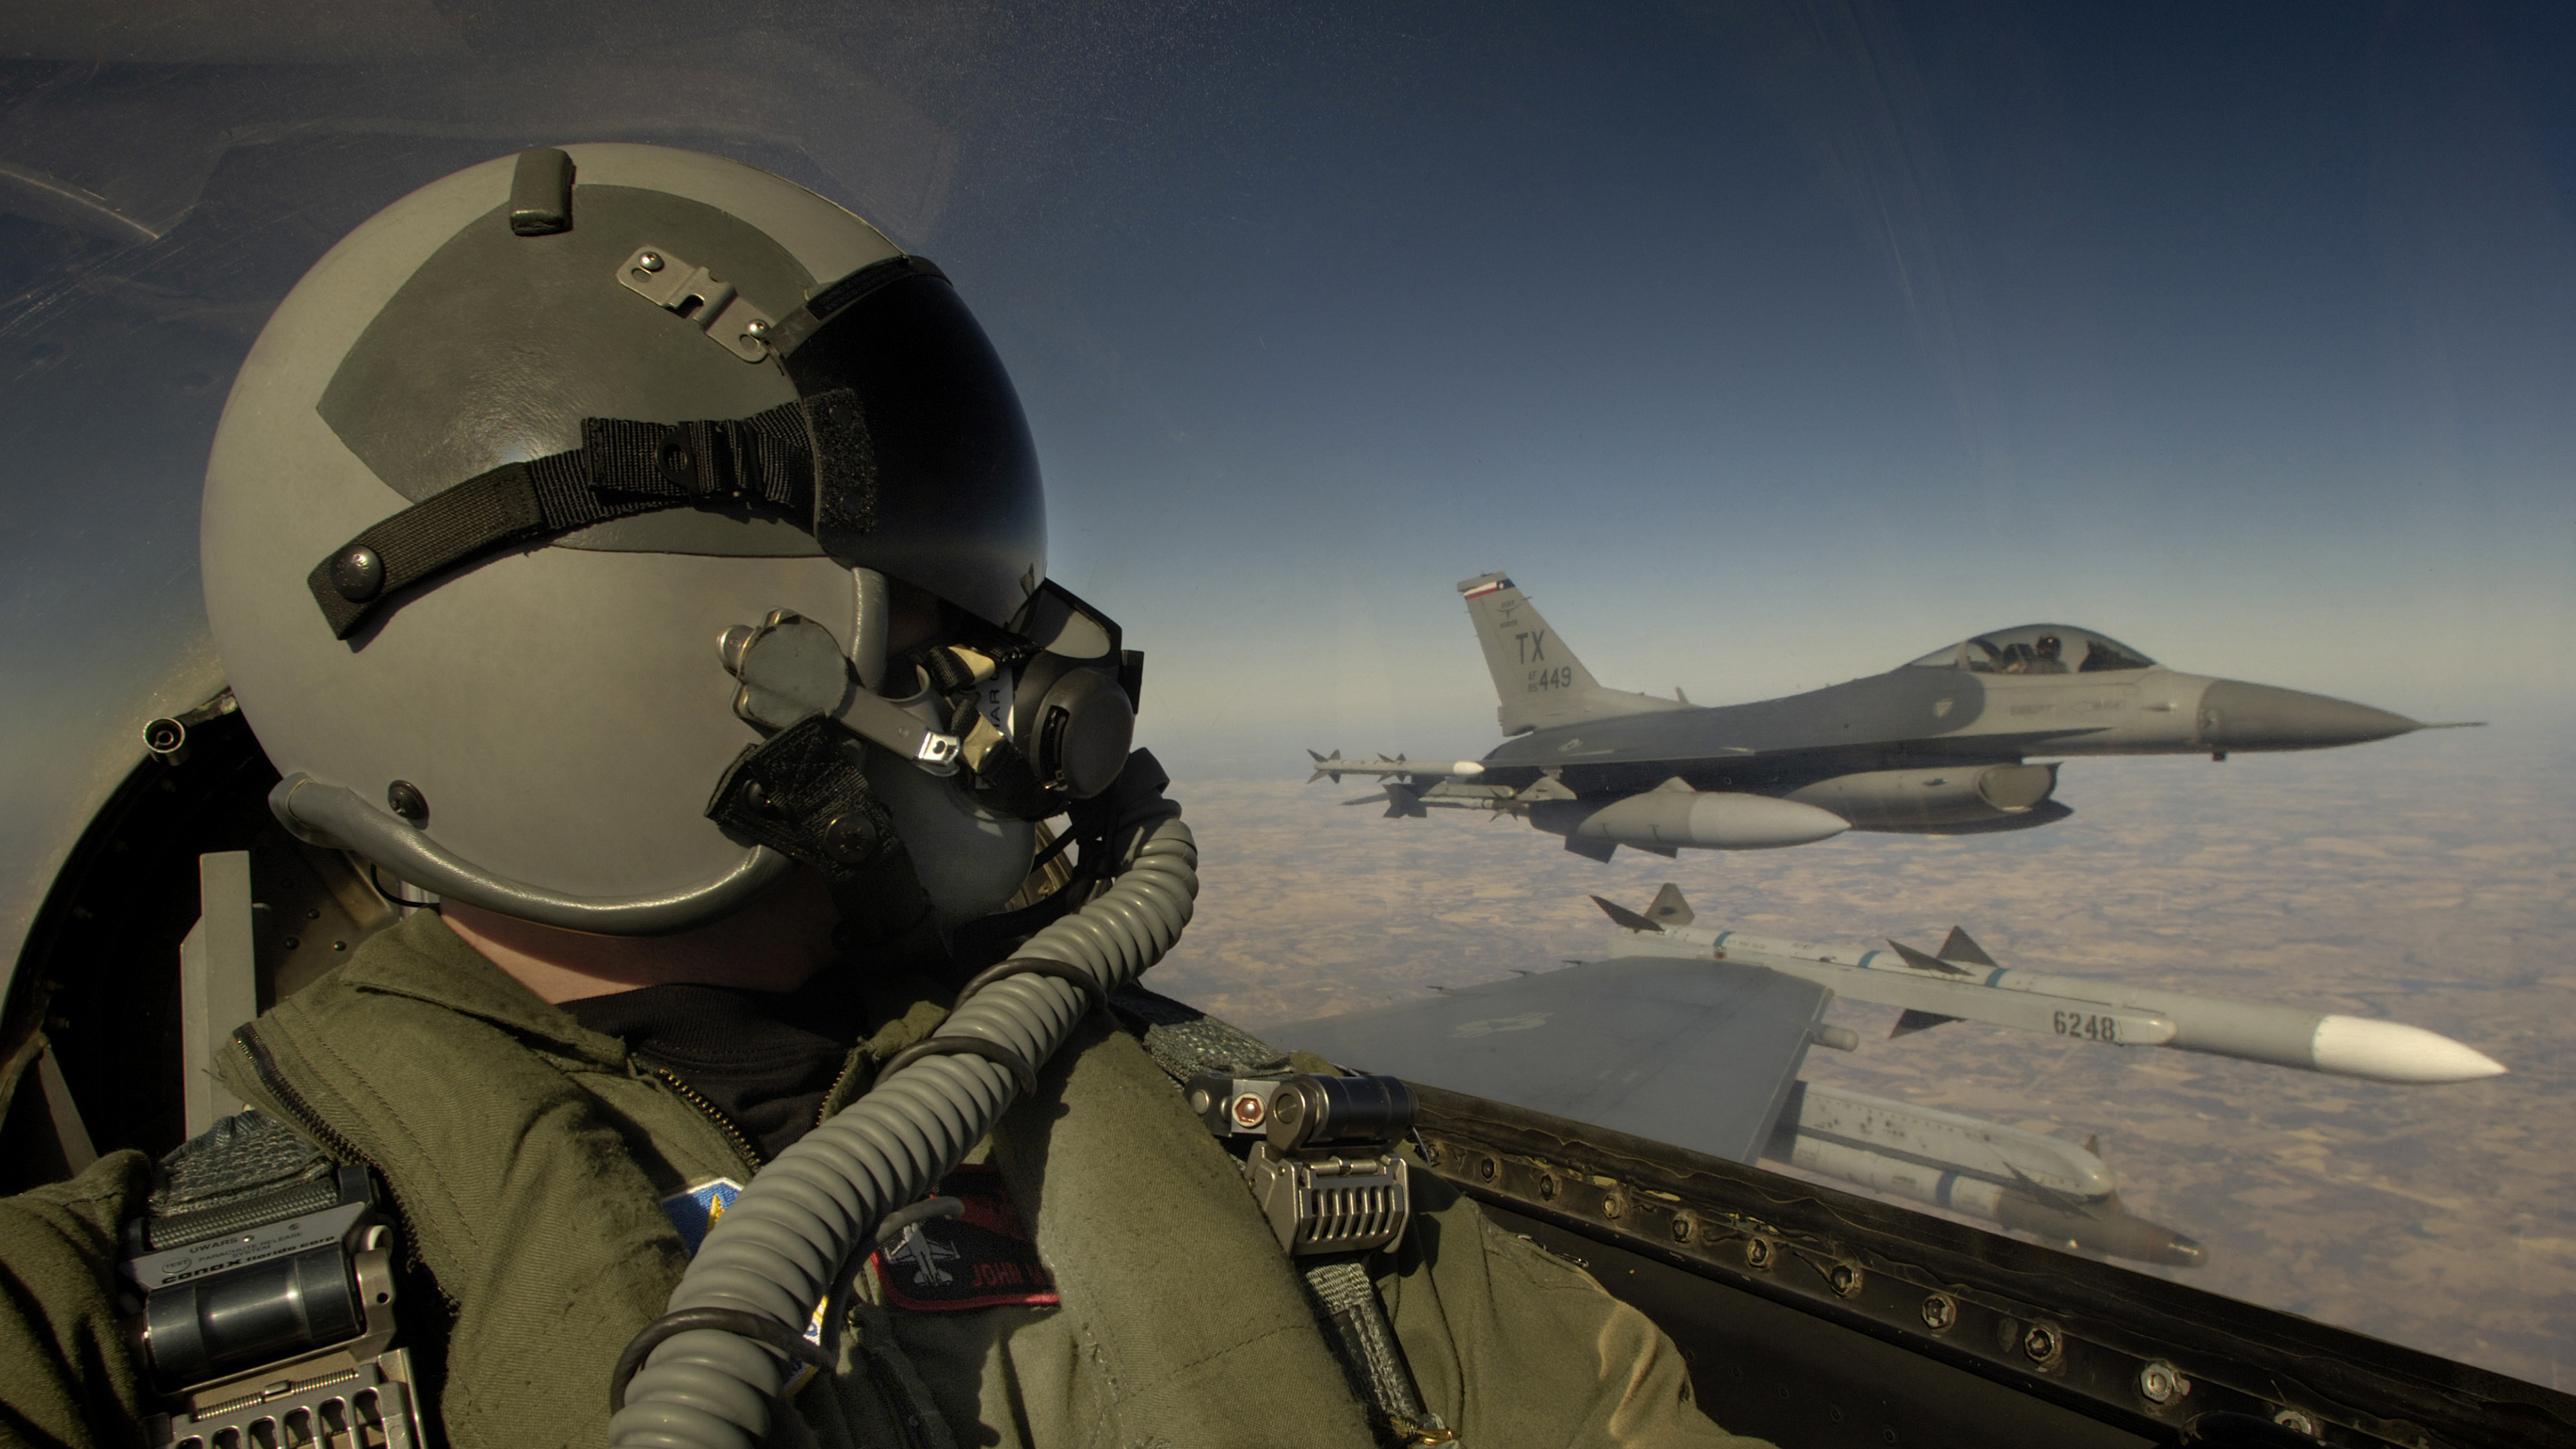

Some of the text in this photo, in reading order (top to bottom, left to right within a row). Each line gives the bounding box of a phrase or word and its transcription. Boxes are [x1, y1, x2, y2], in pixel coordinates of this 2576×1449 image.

[1515, 629, 1546, 664] TX
[1528, 671, 1538, 681] AF
[1539, 666, 1572, 690] 449
[2053, 1010, 2115, 1040] 6248
[190, 1237, 238, 1254] UWARS
[199, 1232, 303, 1262] PARACHUTE RELEASE
[232, 1244, 271, 1258] SYSTEM
[162, 1258, 241, 1285] conax
[300, 1236, 335, 1248] corp
[165, 1259, 188, 1269] TEST
[971, 1261, 1024, 1287] JOHN
